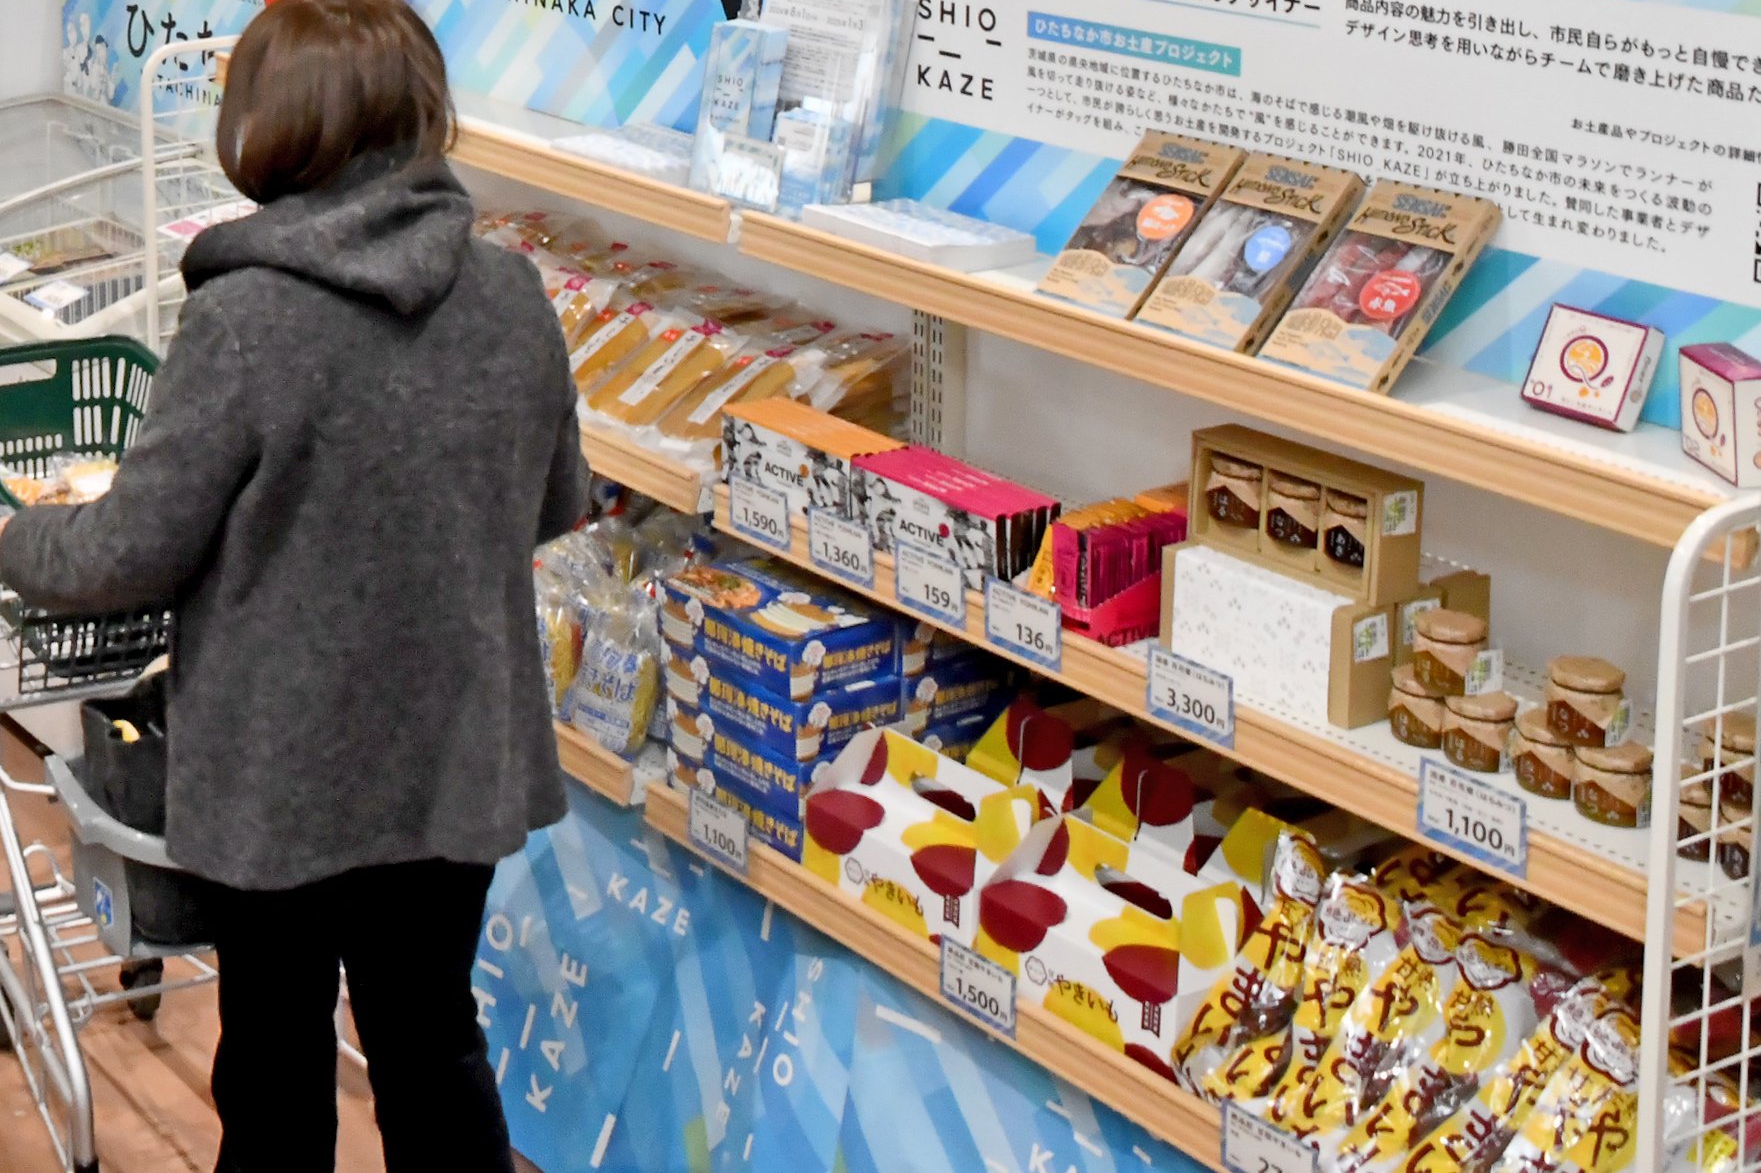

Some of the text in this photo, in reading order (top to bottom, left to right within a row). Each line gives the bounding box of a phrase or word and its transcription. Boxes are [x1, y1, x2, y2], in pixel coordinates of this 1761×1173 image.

[612, 4, 667, 36] CITY
[1034, 17, 1235, 68] ひたちなか市お土産プロジェクト
[917, 63, 995, 102] KAZE
[764, 461, 805, 488] ACTIVE
[899, 519, 945, 547] ACTIVE
[1166, 687, 1225, 730] 3,300円
[1445, 808, 1516, 857] 1,100円
[605, 873, 691, 937] KAZE
[871, 872, 924, 917] やきいも
[1054, 974, 1119, 1024] やきいも
[526, 953, 588, 1113] KAZE
